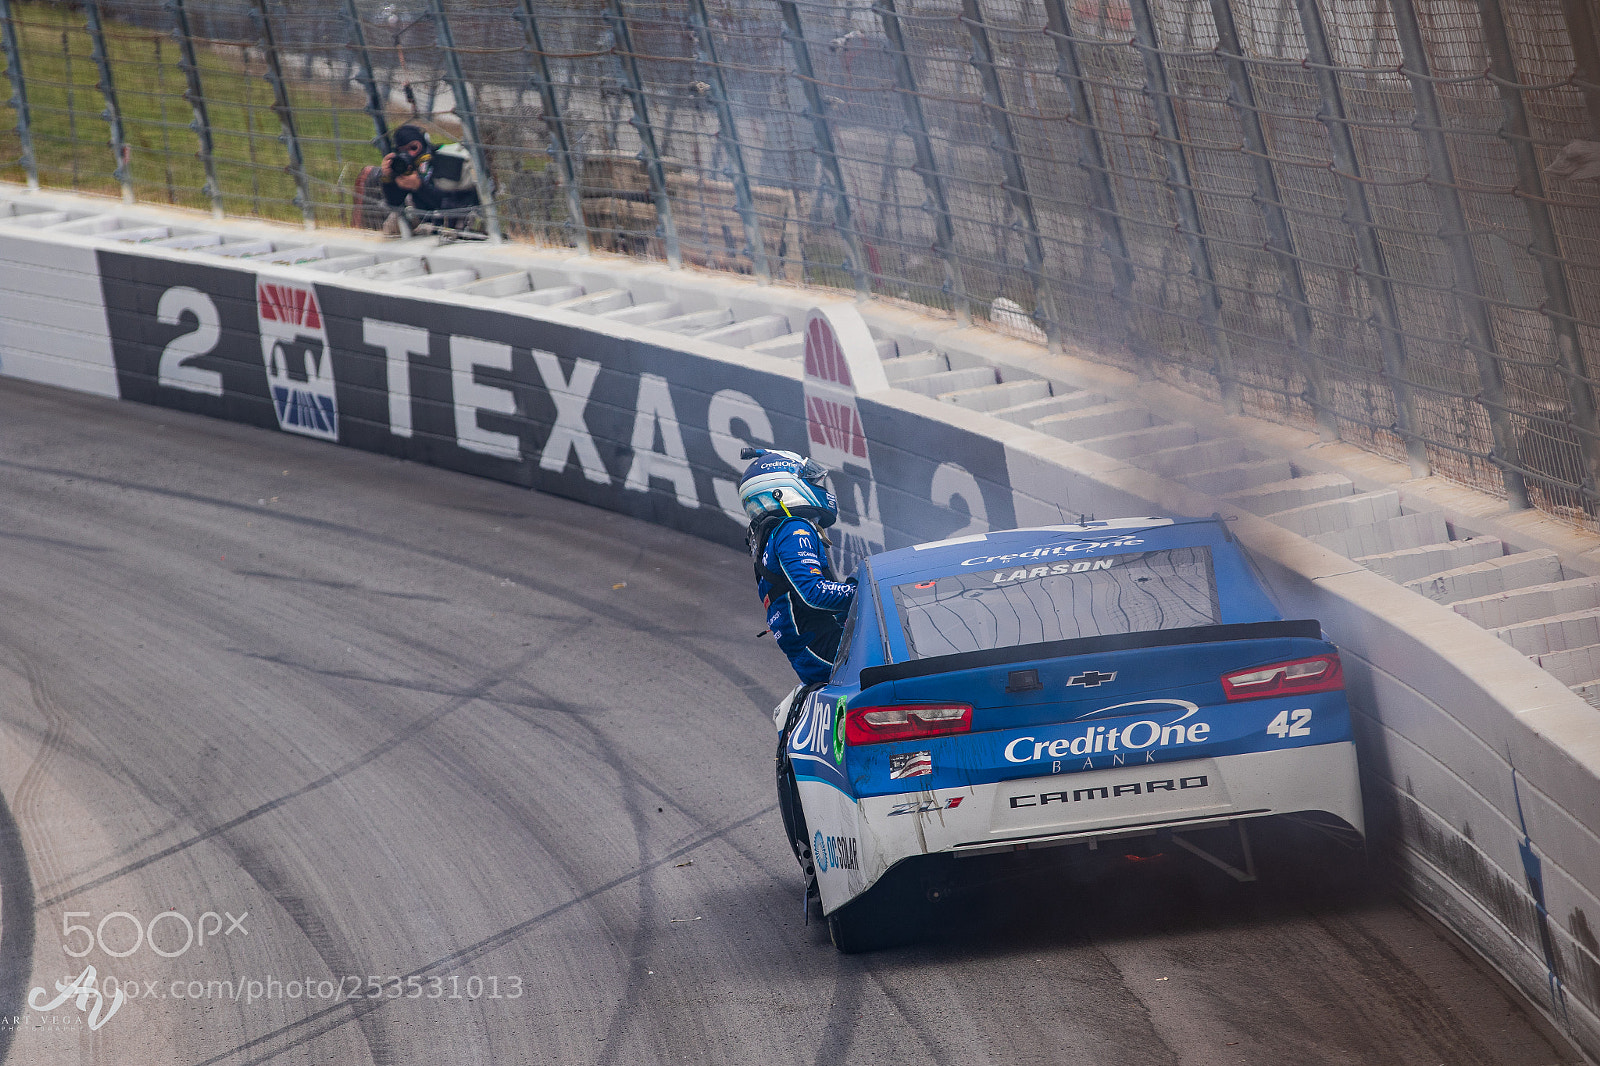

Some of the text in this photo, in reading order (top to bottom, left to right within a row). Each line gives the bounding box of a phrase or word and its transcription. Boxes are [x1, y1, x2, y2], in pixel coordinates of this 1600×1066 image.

[157, 286, 223, 396] 2
[363, 317, 774, 529] TEXAS
[961, 539, 1145, 566] CreditOne
[993, 559, 1114, 584] LARSON
[1266, 708, 1313, 739] 42
[1004, 720, 1211, 763] CreditOne
[1052, 750, 1158, 774] BANK
[1009, 775, 1209, 809] CAMARO
